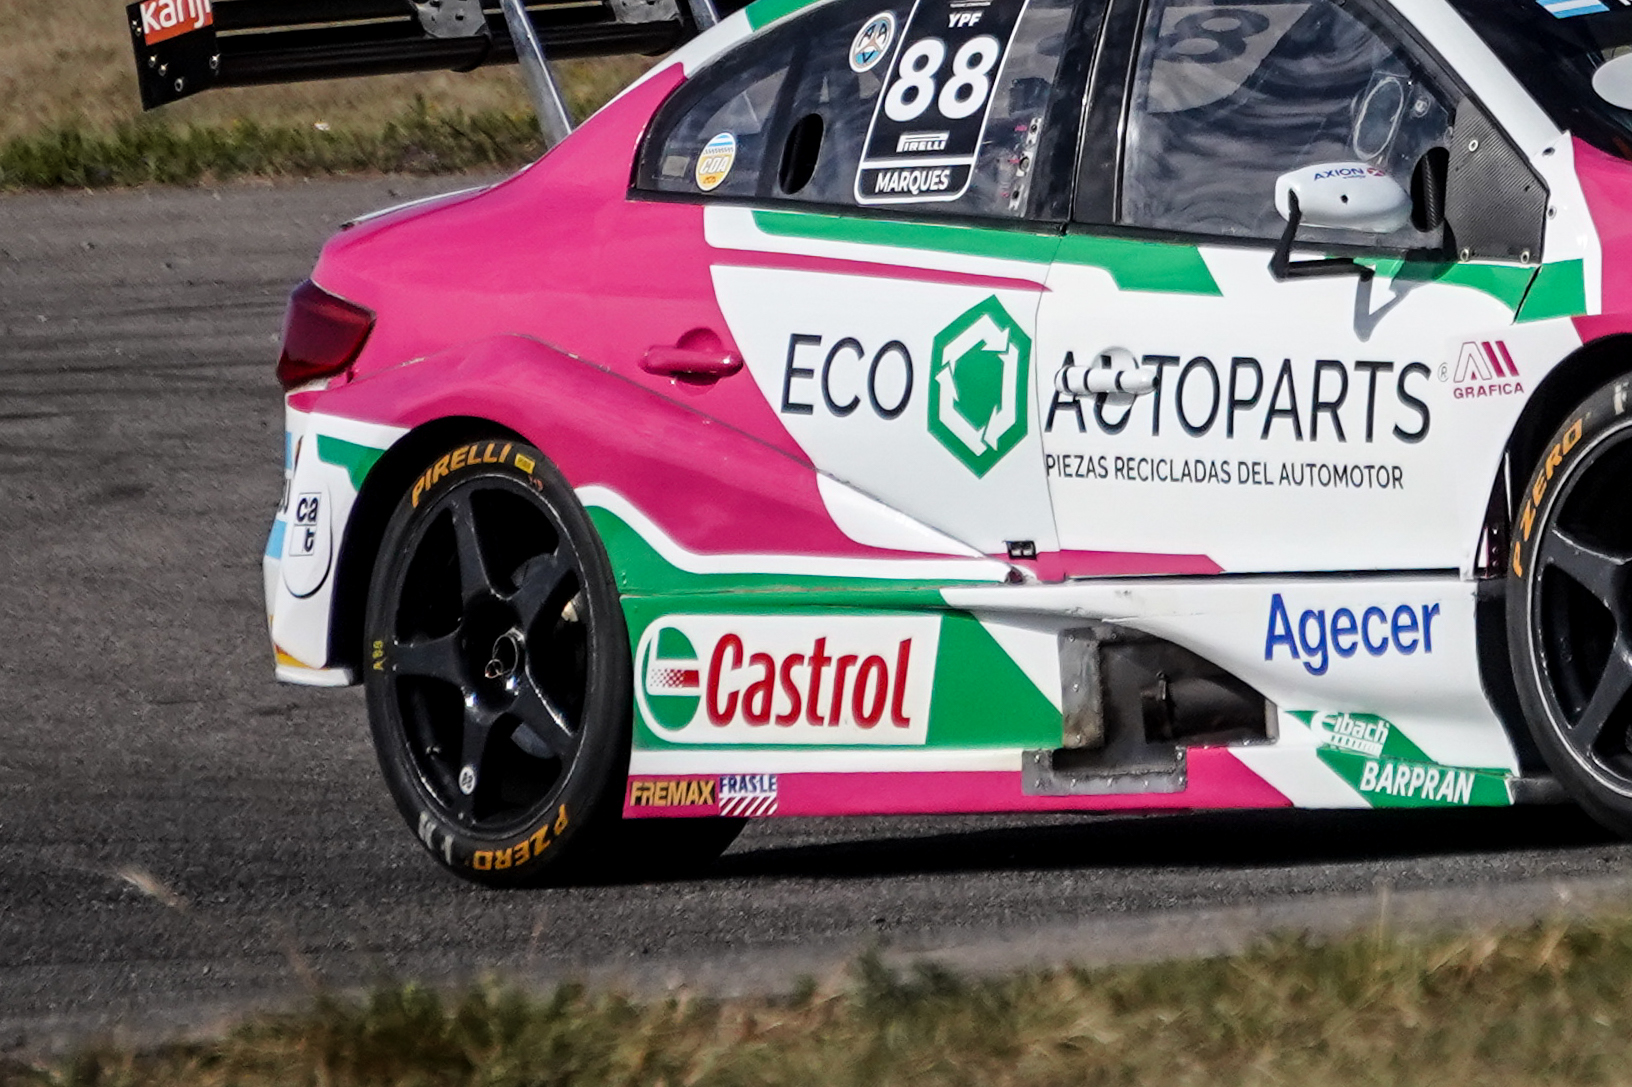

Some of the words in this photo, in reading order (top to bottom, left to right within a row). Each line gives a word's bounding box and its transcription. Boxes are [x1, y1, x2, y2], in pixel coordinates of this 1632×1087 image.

[948, 12, 983, 28] YPF
[884, 36, 1000, 122] 88
[896, 131, 950, 153] PIRELLI
[875, 169, 950, 195] MARQUES
[1314, 168, 1364, 181] AXION
[781, 333, 914, 421] ECO
[1453, 382, 1525, 400] GRAFICA
[412, 442, 512, 508] PIRELLI
[1045, 453, 1109, 480] PIEZAS
[1113, 456, 1232, 485] RECICLADAS
[1238, 462, 1274, 487] DEL
[1279, 463, 1404, 490] AUTOMOTOR
[1264, 593, 1440, 676] Agecer
[705, 633, 913, 730] Castrol
[630, 780, 715, 806] FREMAX
[1359, 761, 1476, 804] BARPRAN
[473, 824, 551, 870] ZERO
